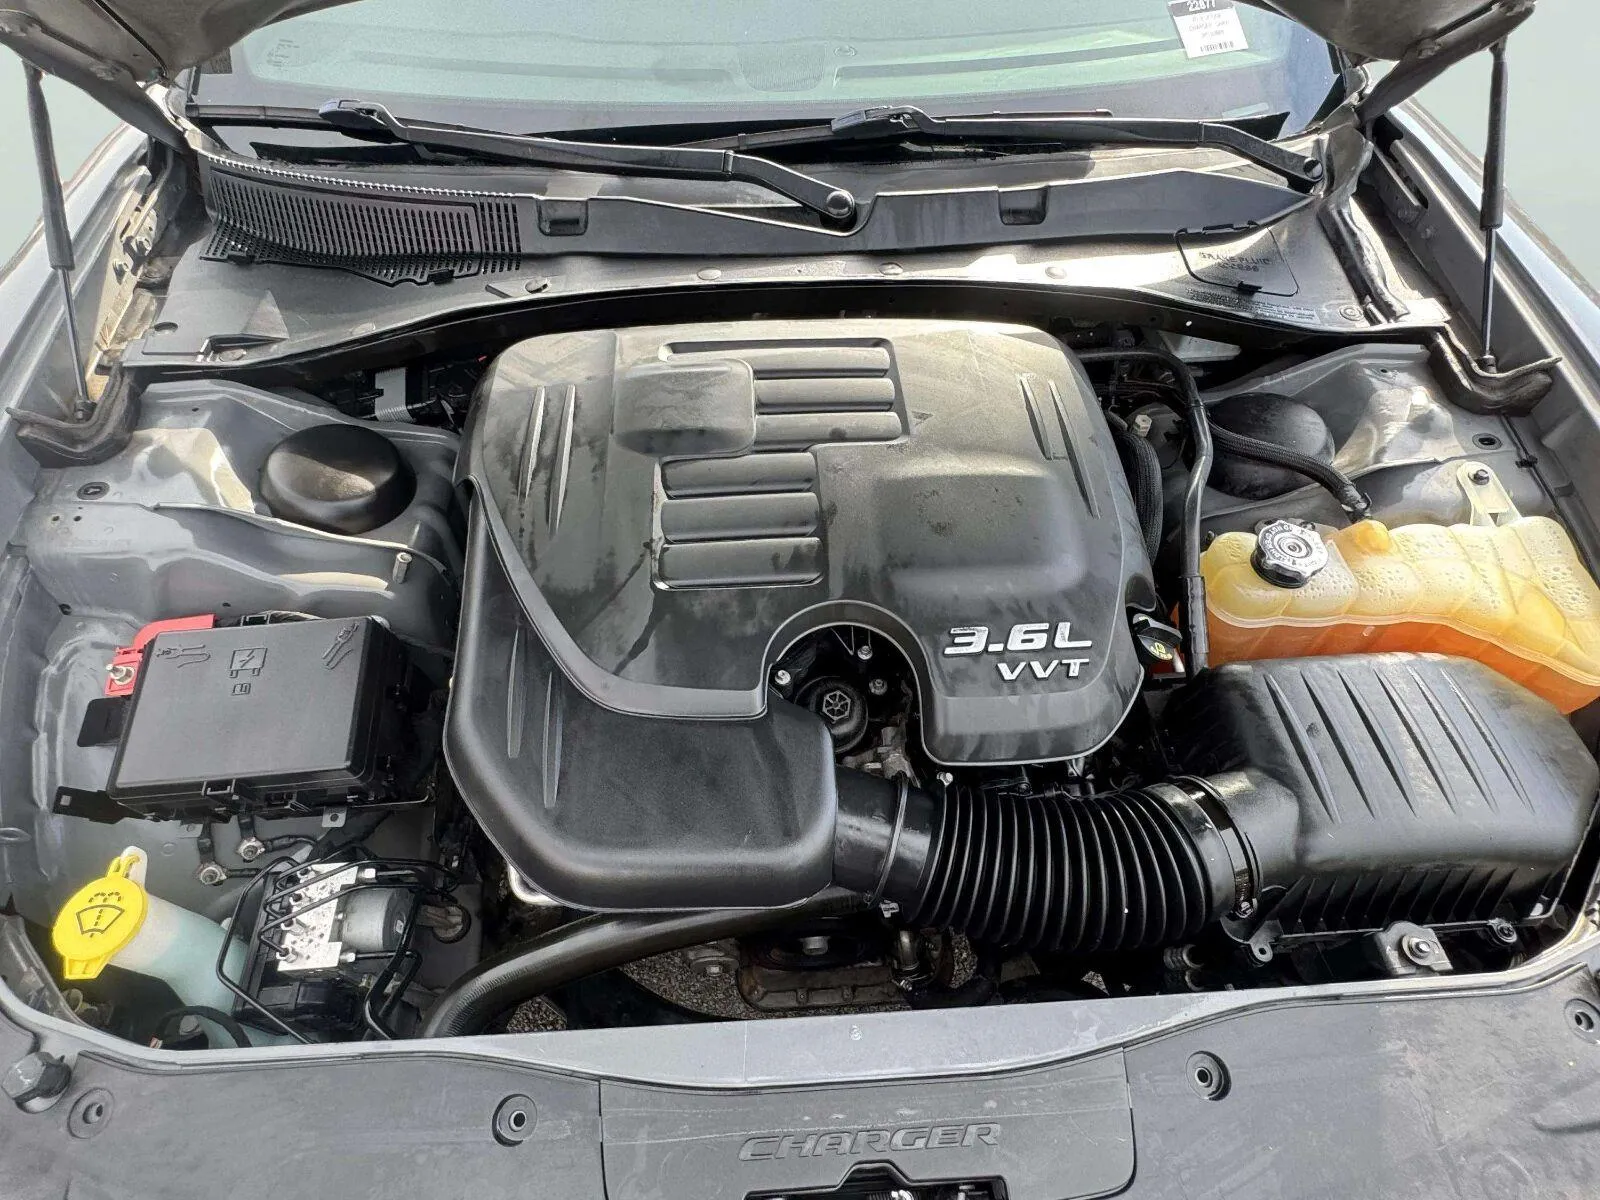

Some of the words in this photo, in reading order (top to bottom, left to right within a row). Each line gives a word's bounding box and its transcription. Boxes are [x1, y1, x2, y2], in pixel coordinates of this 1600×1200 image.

[944, 622, 1092, 655] 3.6L
[997, 658, 1090, 681] VVT
[738, 1122, 1001, 1161] CHARGER
